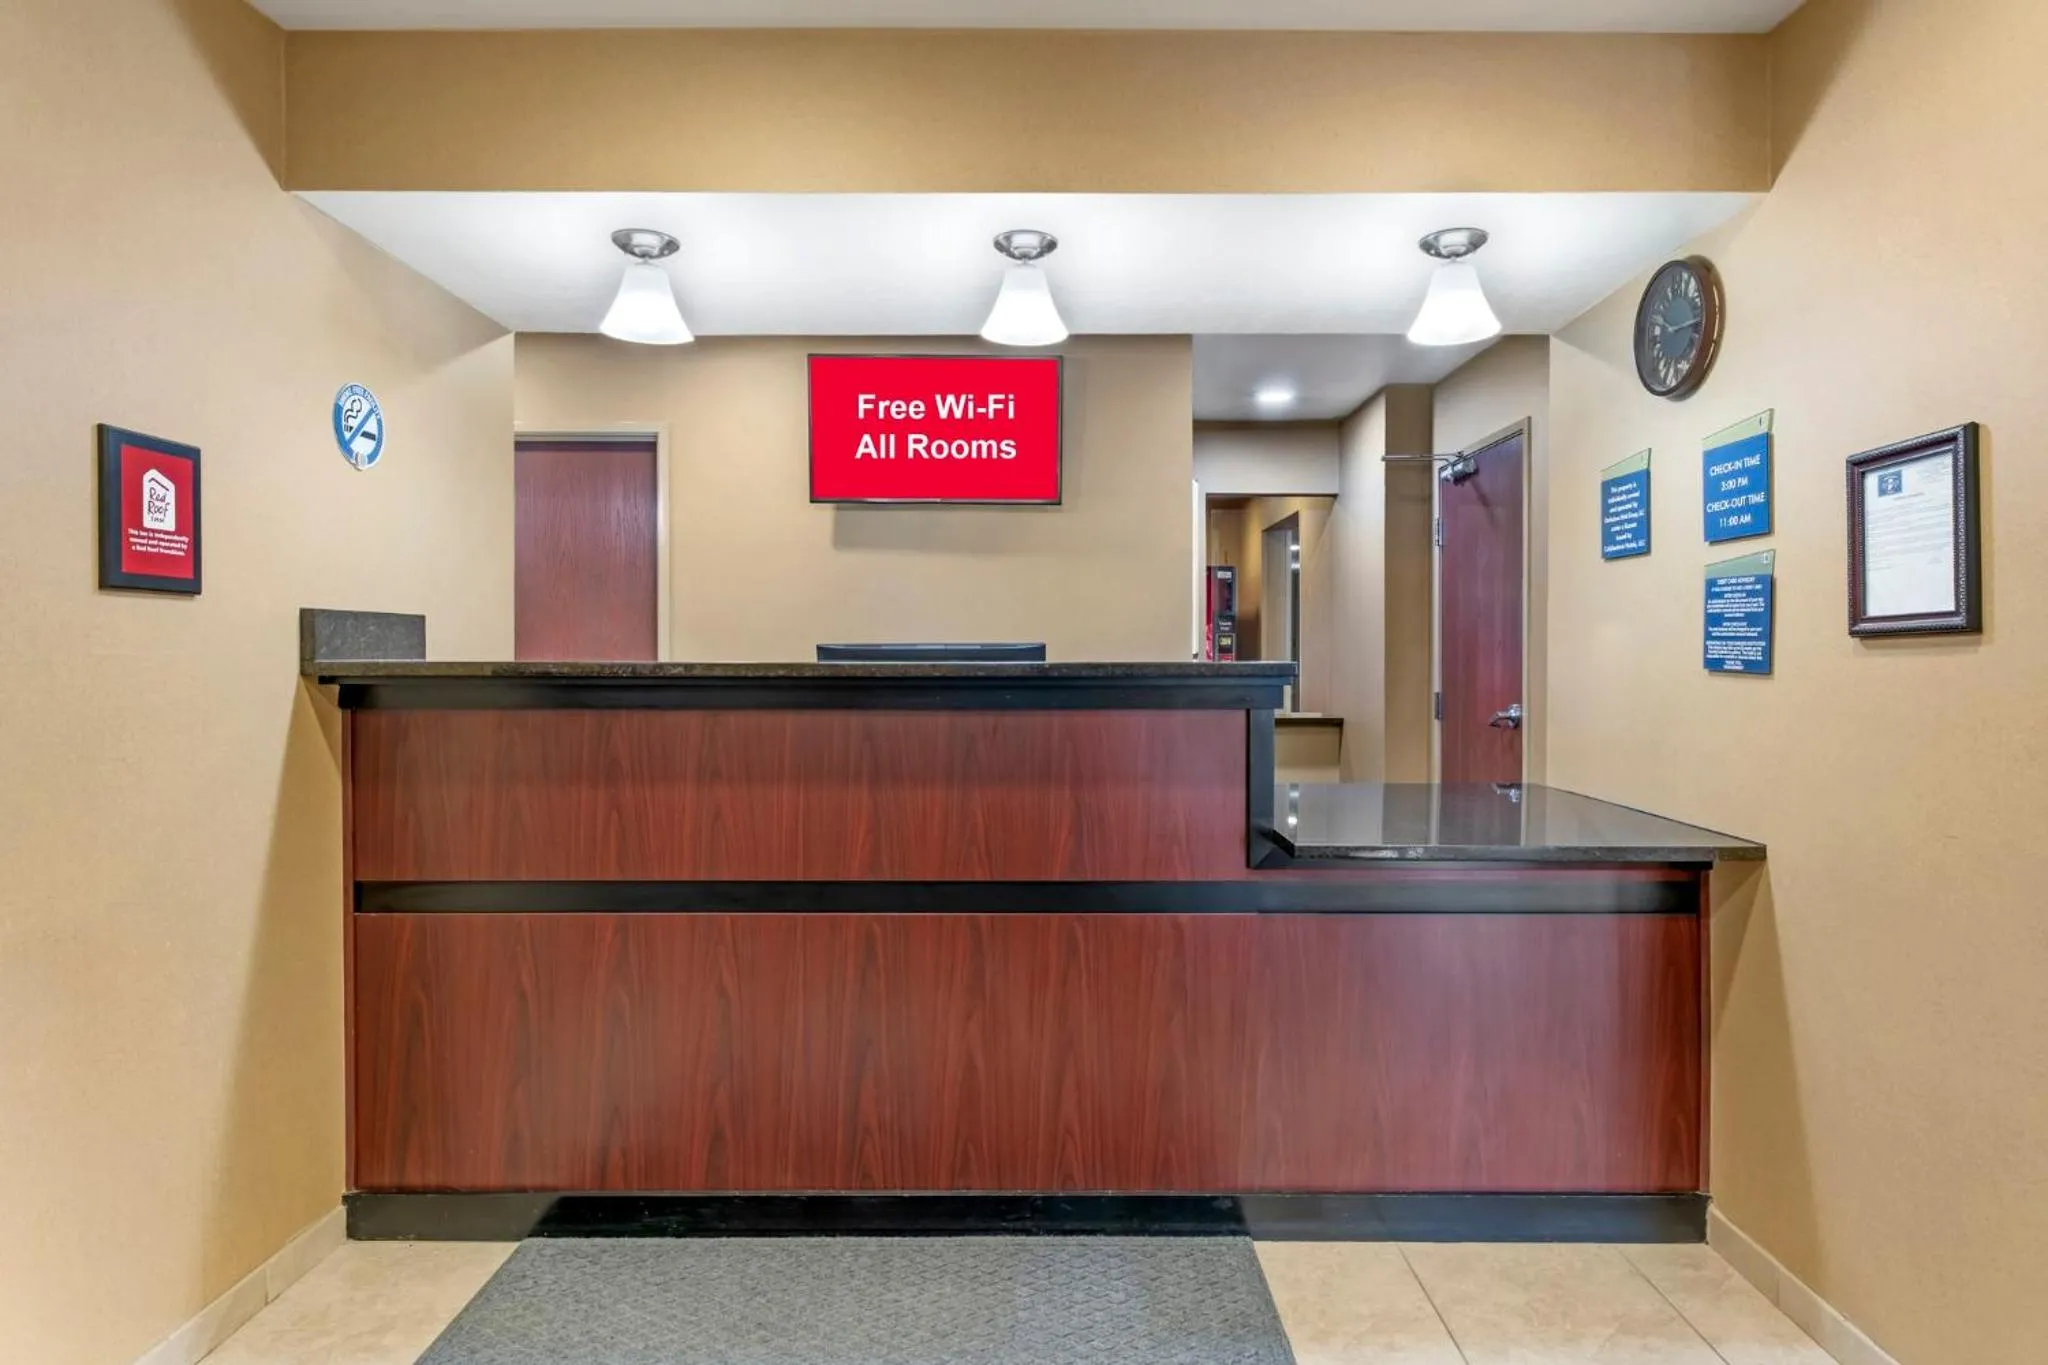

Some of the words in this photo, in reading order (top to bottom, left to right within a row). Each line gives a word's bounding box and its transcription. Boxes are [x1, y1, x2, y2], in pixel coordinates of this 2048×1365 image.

[857, 394, 926, 420] Free
[934, 394, 1015, 420] Wi-Fi
[855, 433, 896, 459] All
[907, 433, 1017, 460] Rooms
[1709, 459, 1742, 476] CHECK-IN
[1743, 454, 1761, 469] TIME
[1720, 478, 1736, 492] 3:00
[1737, 476, 1748, 488] PM
[149, 487, 167, 501] Red
[1706, 495, 1747, 513] CHECK-OUT
[1747, 491, 1765, 506] TIME
[148, 500, 170, 517] Roof
[1720, 515, 1738, 528] 11:00
[1739, 513, 1752, 525] AM
